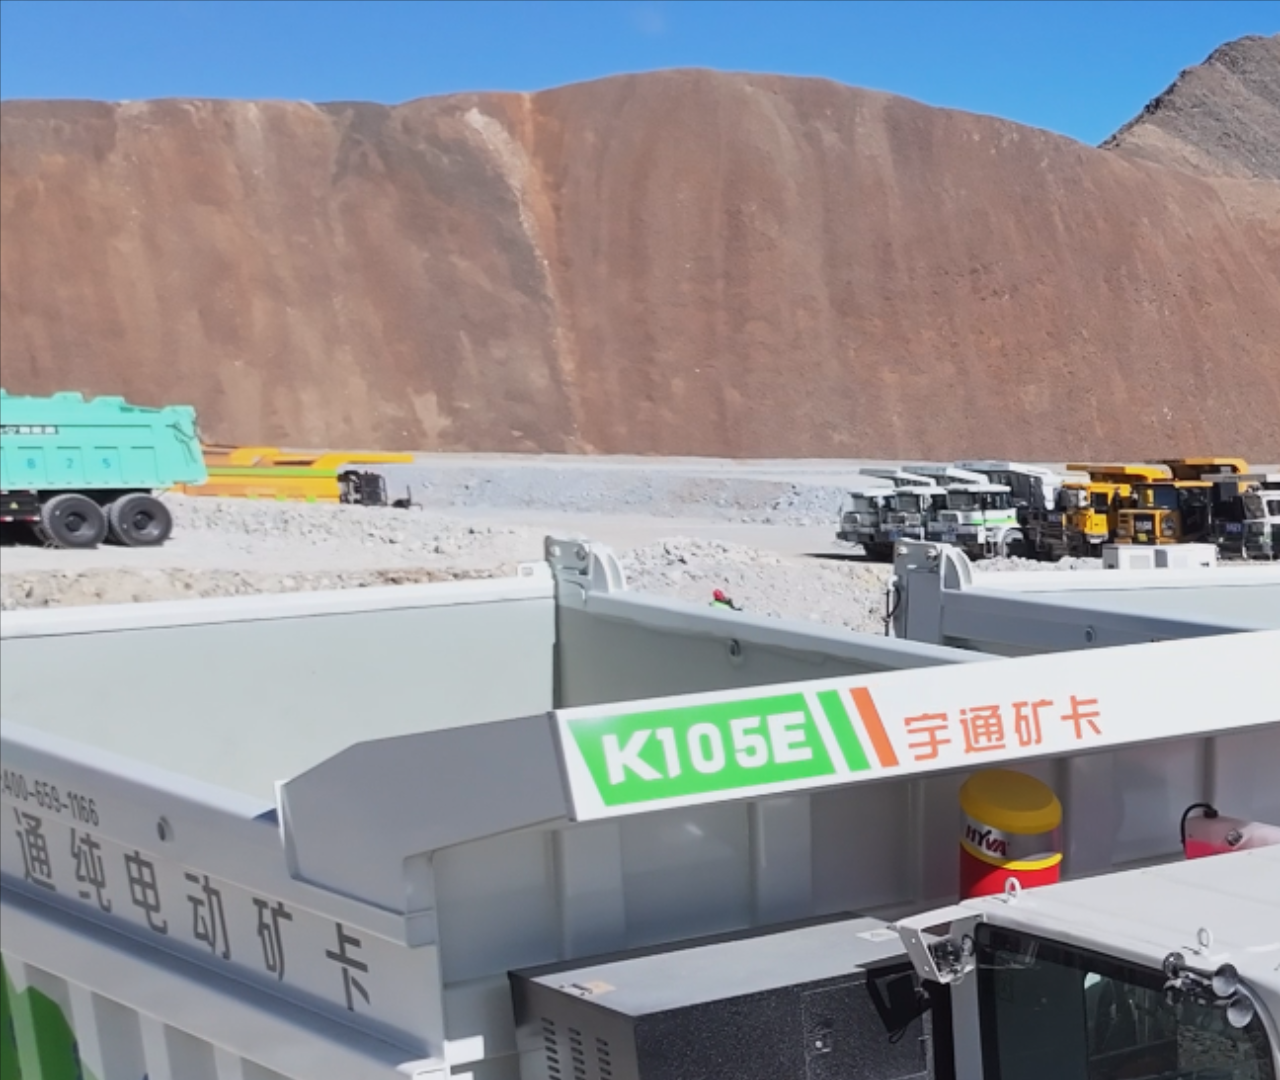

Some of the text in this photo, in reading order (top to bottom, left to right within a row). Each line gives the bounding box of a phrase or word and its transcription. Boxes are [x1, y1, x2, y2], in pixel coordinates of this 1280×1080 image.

[601, 695, 1103, 785] K105E 宇通矿卡
[965, 824, 1007, 857] HYVA
[13, 806, 371, 1013] 通纯电动矿卡
